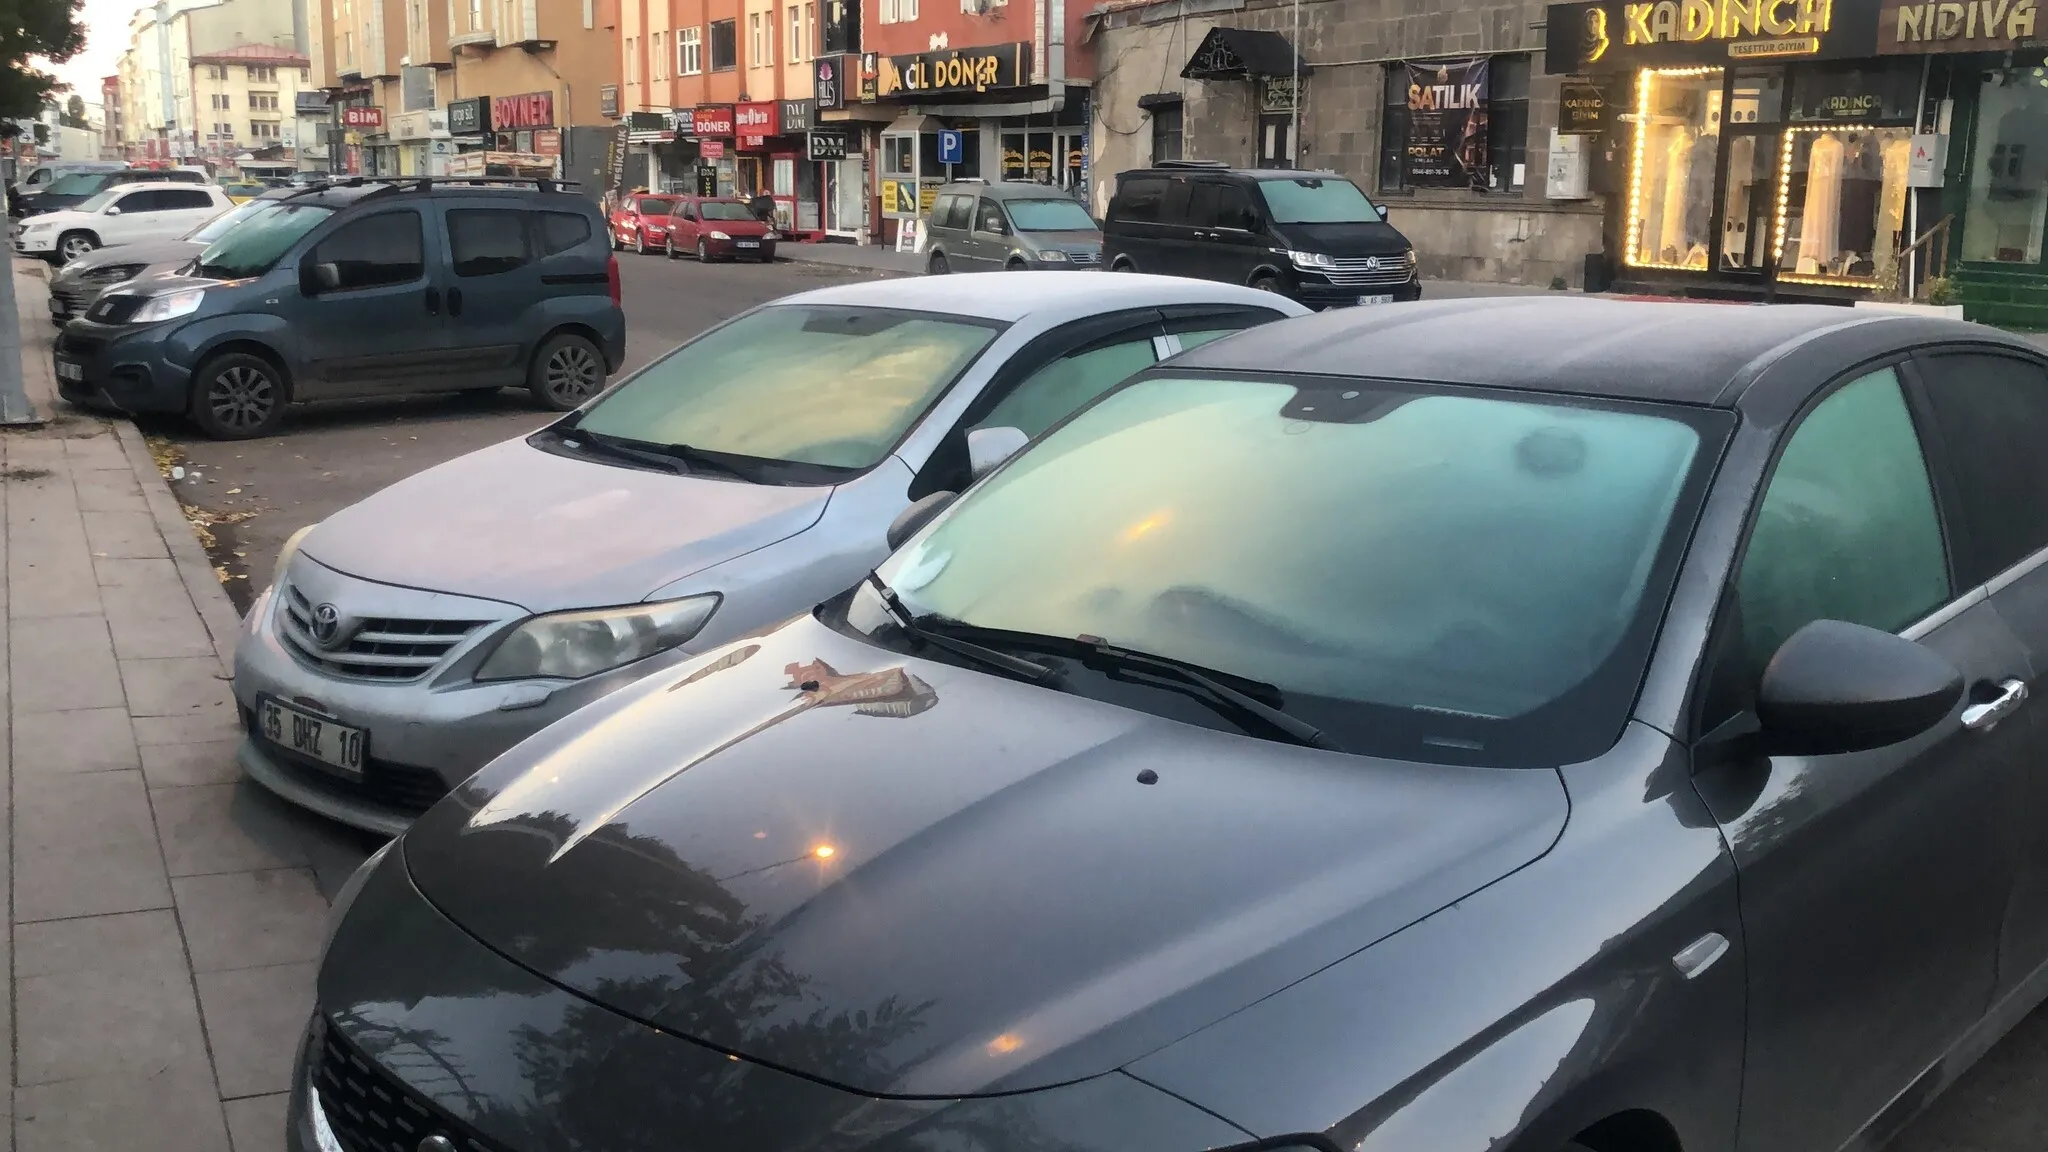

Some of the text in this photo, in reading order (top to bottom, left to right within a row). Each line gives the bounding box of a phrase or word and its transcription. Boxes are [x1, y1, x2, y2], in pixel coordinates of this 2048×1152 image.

[935, 52, 998, 92] DÖNER
[1408, 84, 1482, 110] SATILIK
[348, 108, 379, 124] BİM
[494, 94, 549, 128] BOYNER
[812, 137, 844, 156] DM
[943, 136, 957, 160] P
[1408, 147, 1445, 157] POLAT
[265, 704, 360, 768] 35 DHZ 10
